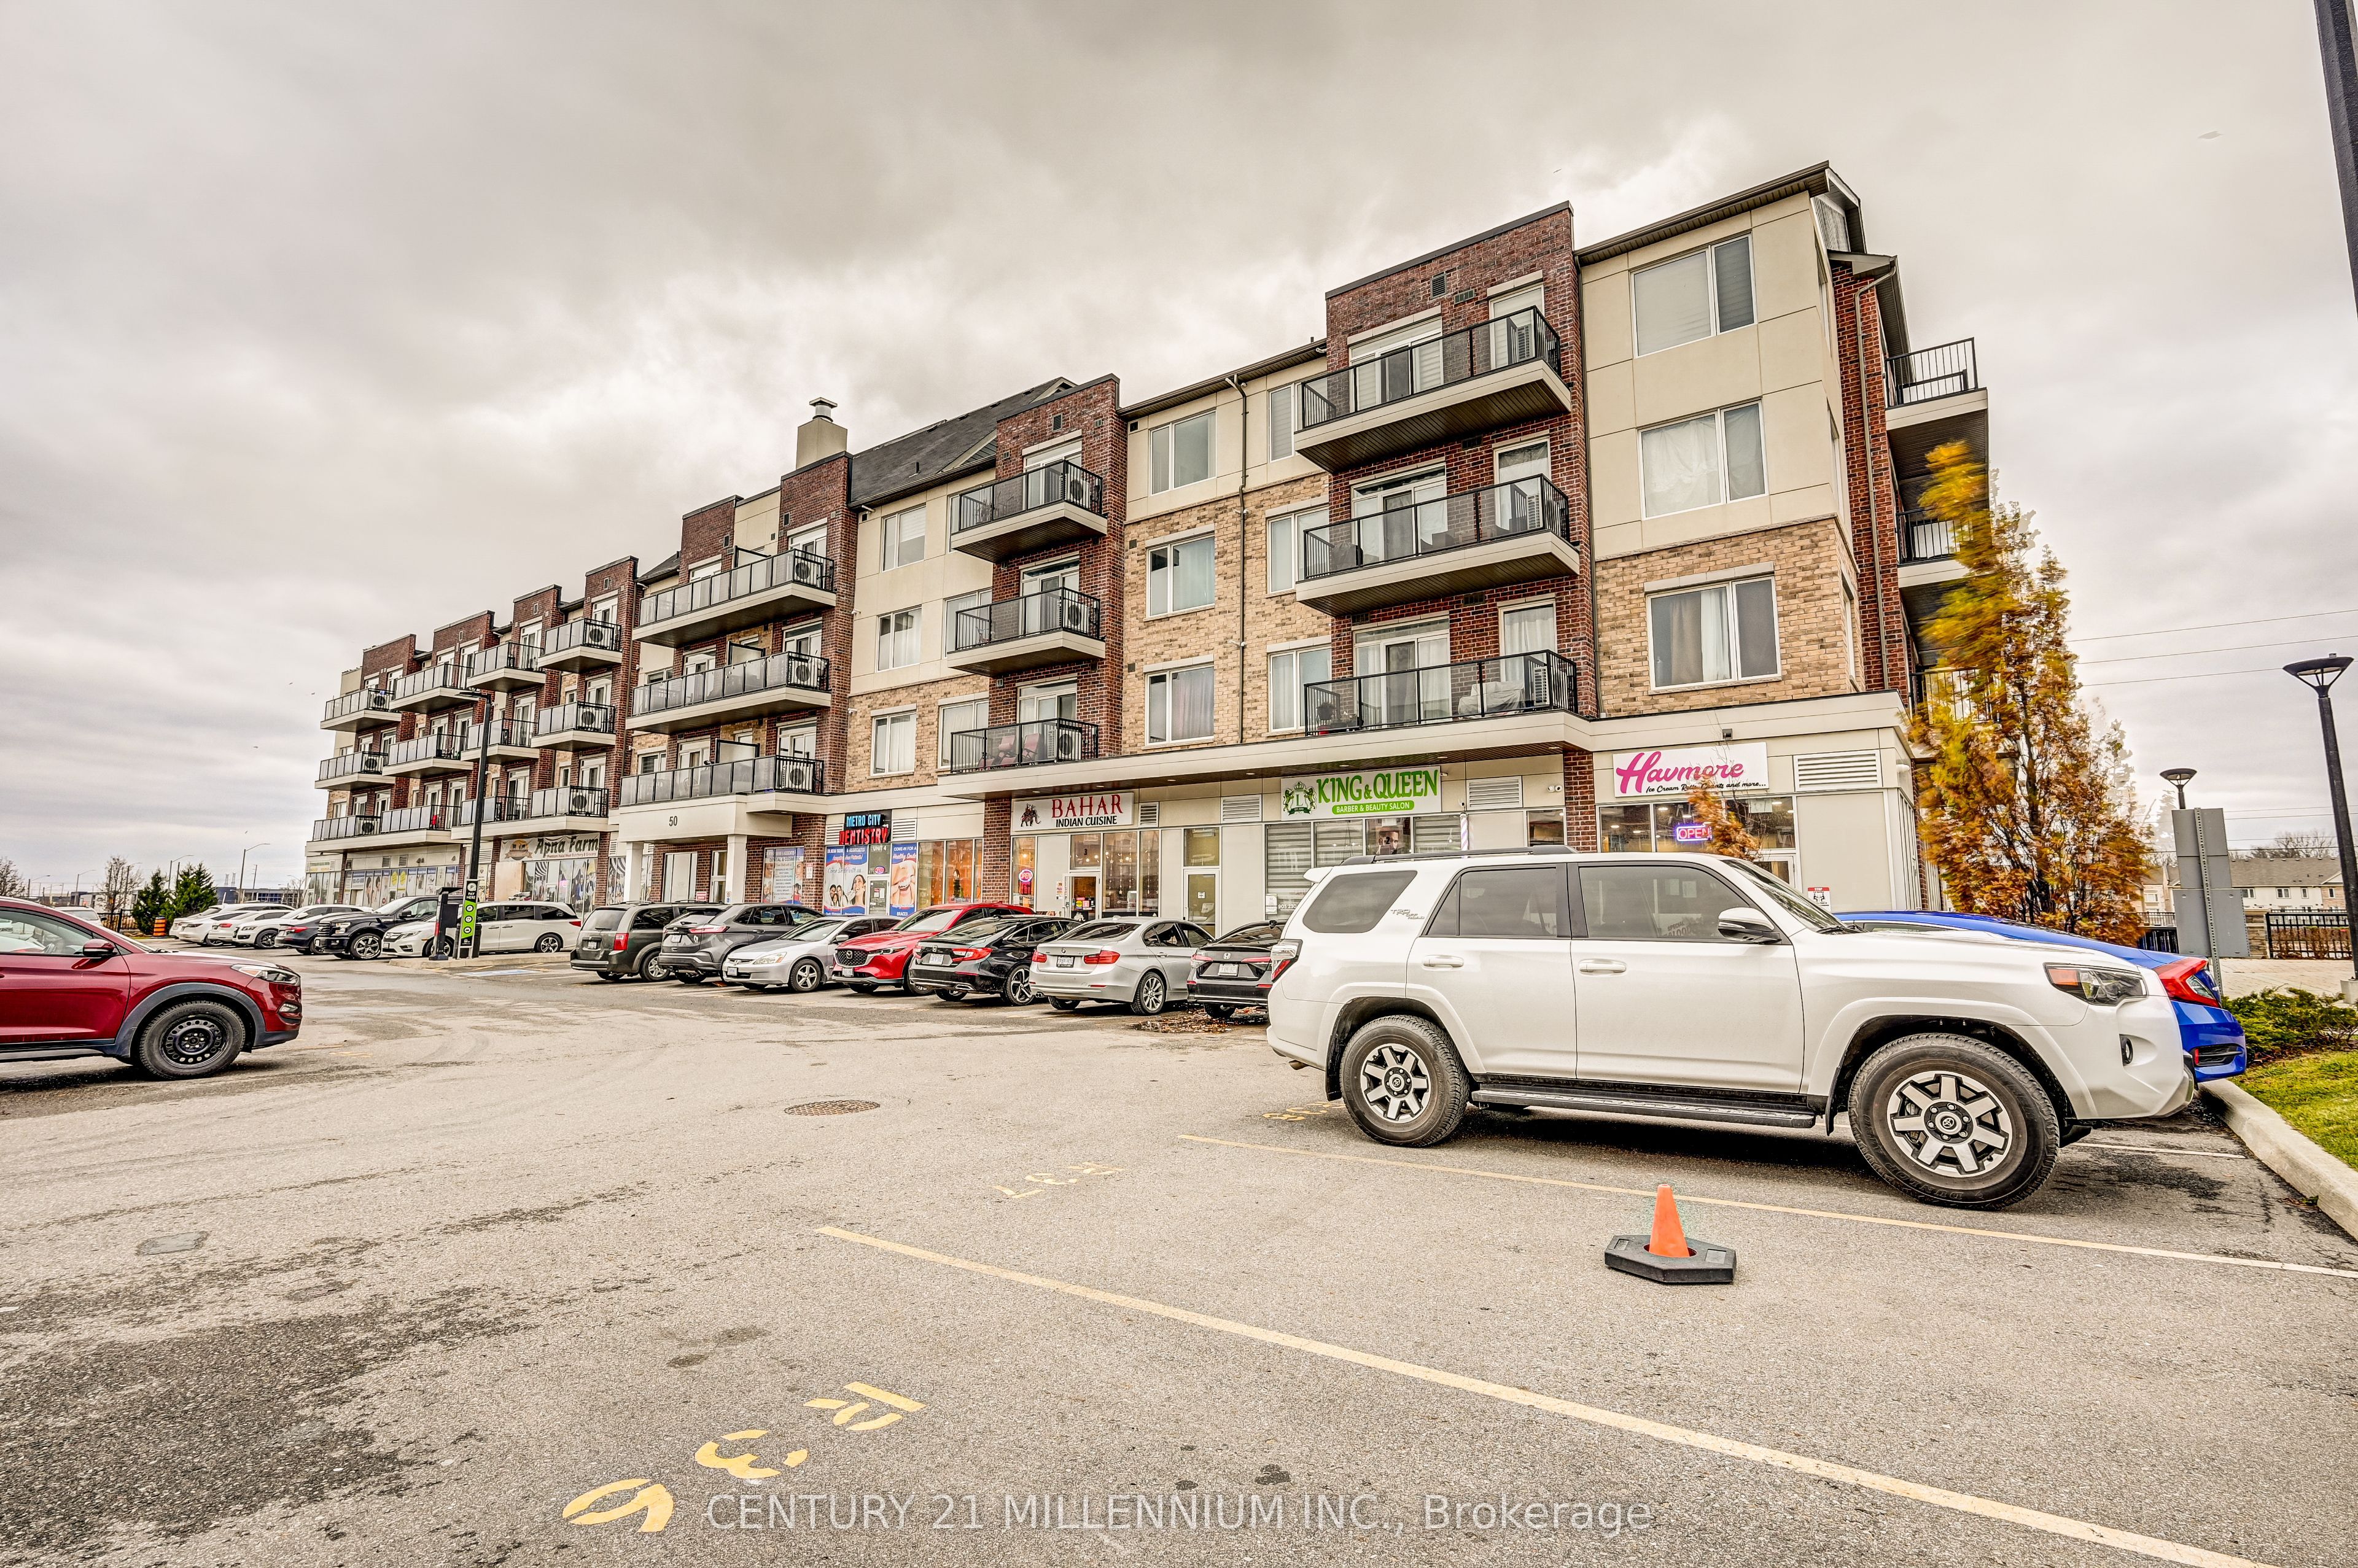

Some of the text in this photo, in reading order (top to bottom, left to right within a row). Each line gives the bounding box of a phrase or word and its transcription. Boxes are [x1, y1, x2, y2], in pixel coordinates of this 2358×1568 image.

[1616, 751, 1744, 794] Havmore
[1316, 769, 1438, 804] KING & QUEEN
[1051, 794, 1123, 818] BAHAR
[1365, 803, 1388, 812] BEAUTY
[669, 815, 678, 827] 50
[846, 814, 881, 827] METRO CITY
[1056, 815, 1118, 828] INDIAN CUISINE
[839, 828, 888, 845] DENTISTRY
[1679, 828, 1710, 839] OPEN
[534, 836, 599, 858] Apna Farm
[1667, 921, 1685, 931] SPECIAL
